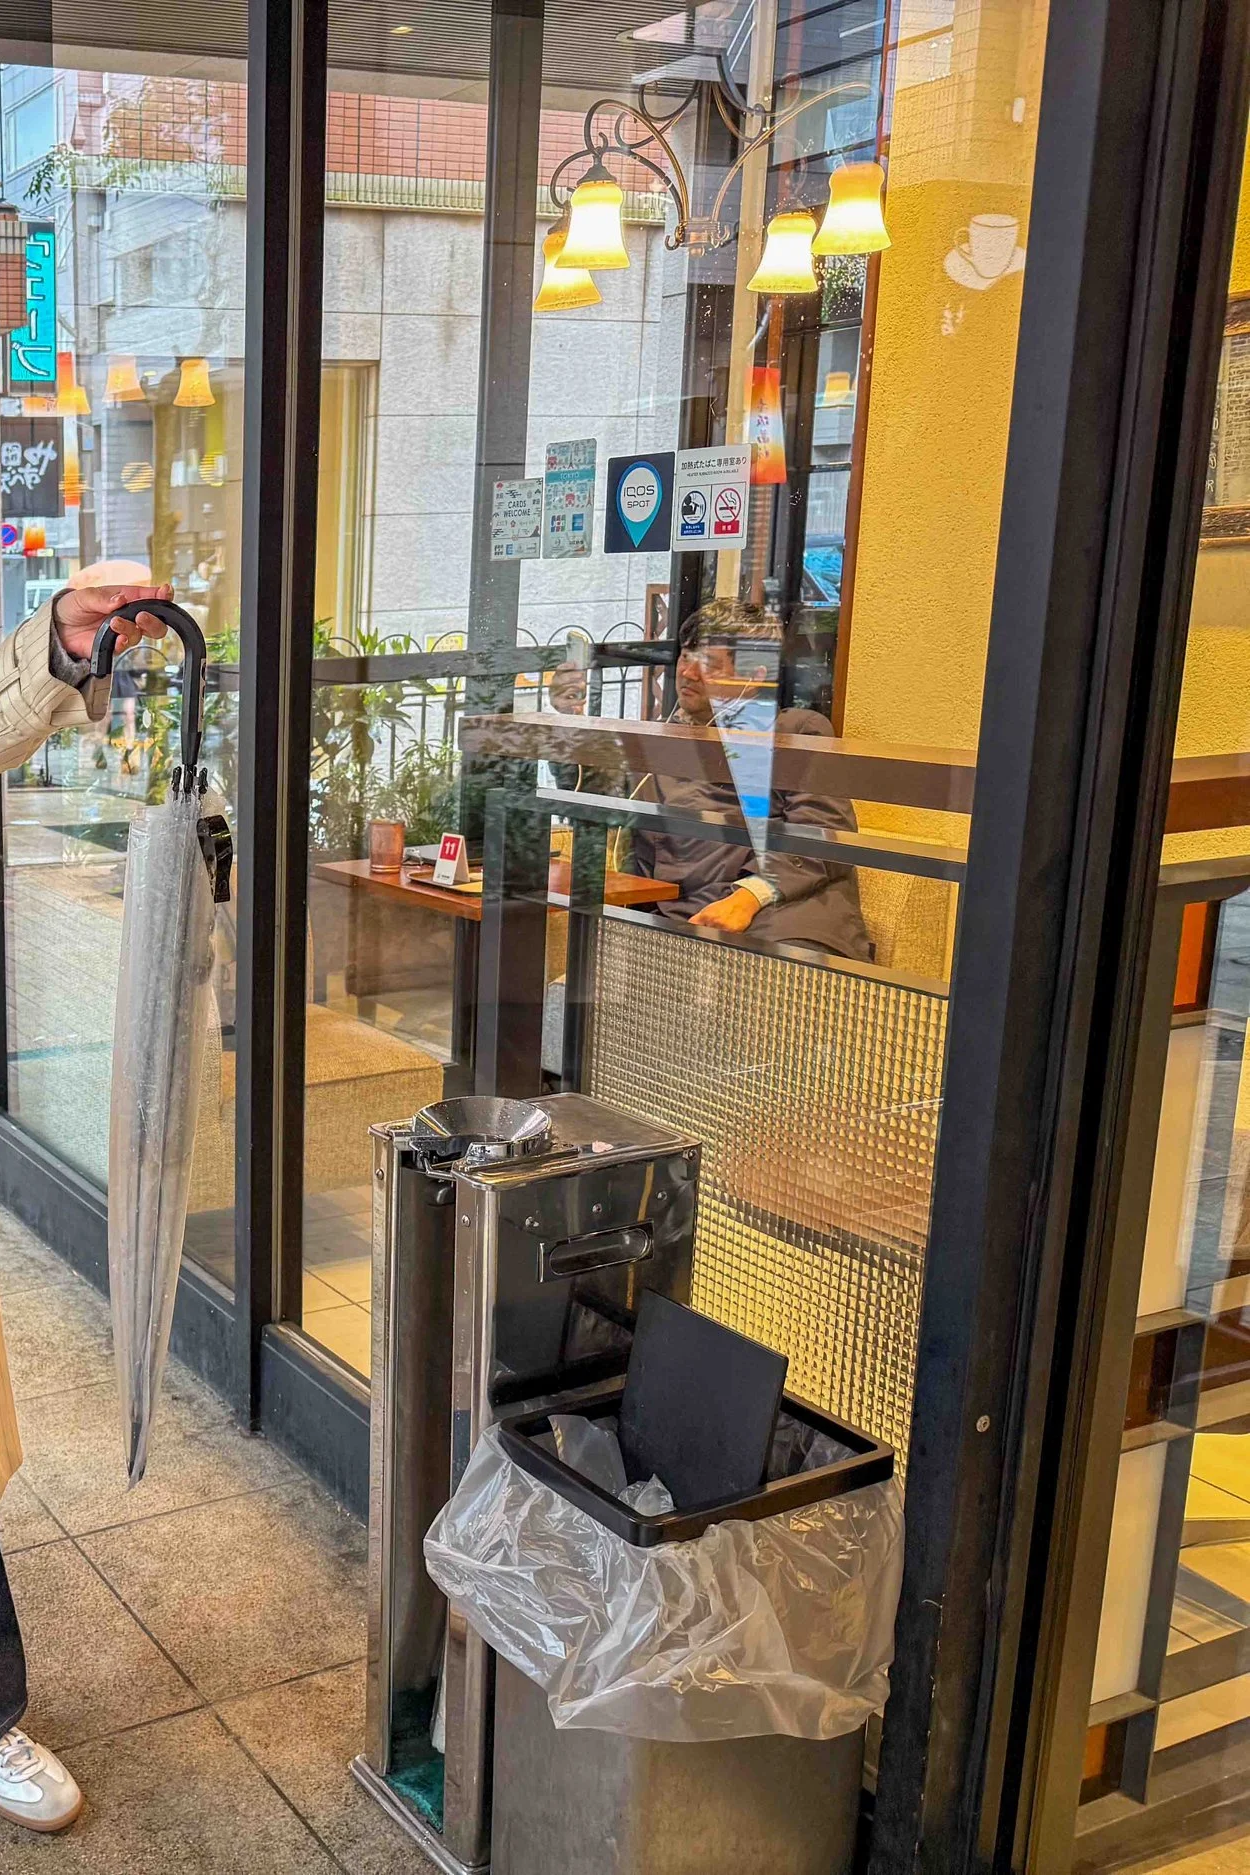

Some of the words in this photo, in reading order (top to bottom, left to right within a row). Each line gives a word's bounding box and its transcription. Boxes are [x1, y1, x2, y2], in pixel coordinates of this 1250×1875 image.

[681, 456, 747, 470] 加熱式たばこ専用室あり
[624, 485, 654, 498] IQOS
[507, 500, 527, 509] CARDS
[627, 500, 650, 508] SPOT
[503, 509, 531, 518] WELCOME
[445, 841, 456, 855] 11
